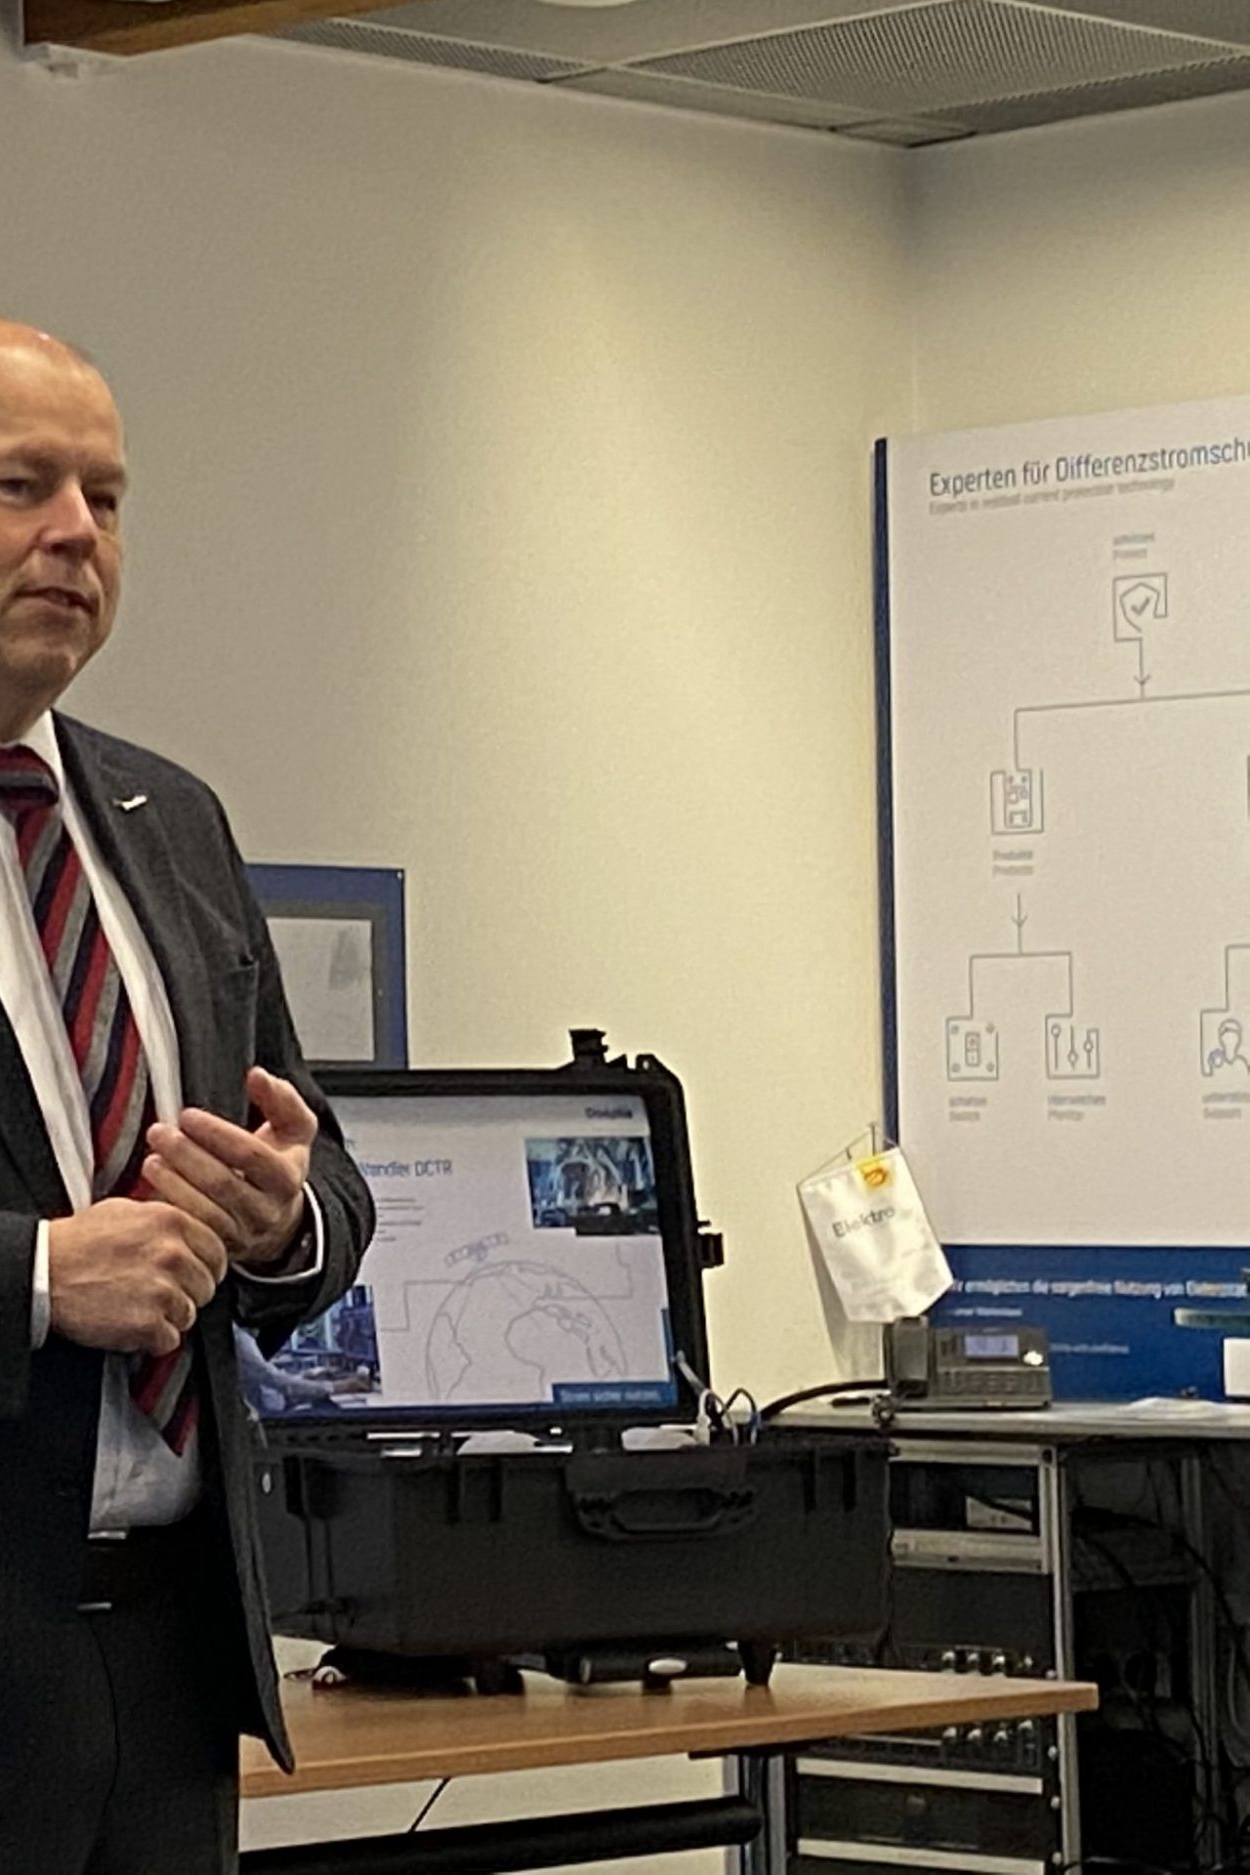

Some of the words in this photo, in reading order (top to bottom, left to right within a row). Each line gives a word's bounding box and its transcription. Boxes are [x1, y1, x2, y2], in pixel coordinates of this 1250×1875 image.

[930, 468, 1017, 498] Experten
[1023, 461, 1050, 485] für
[1056, 437, 1250, 482] Differenzstromsch
